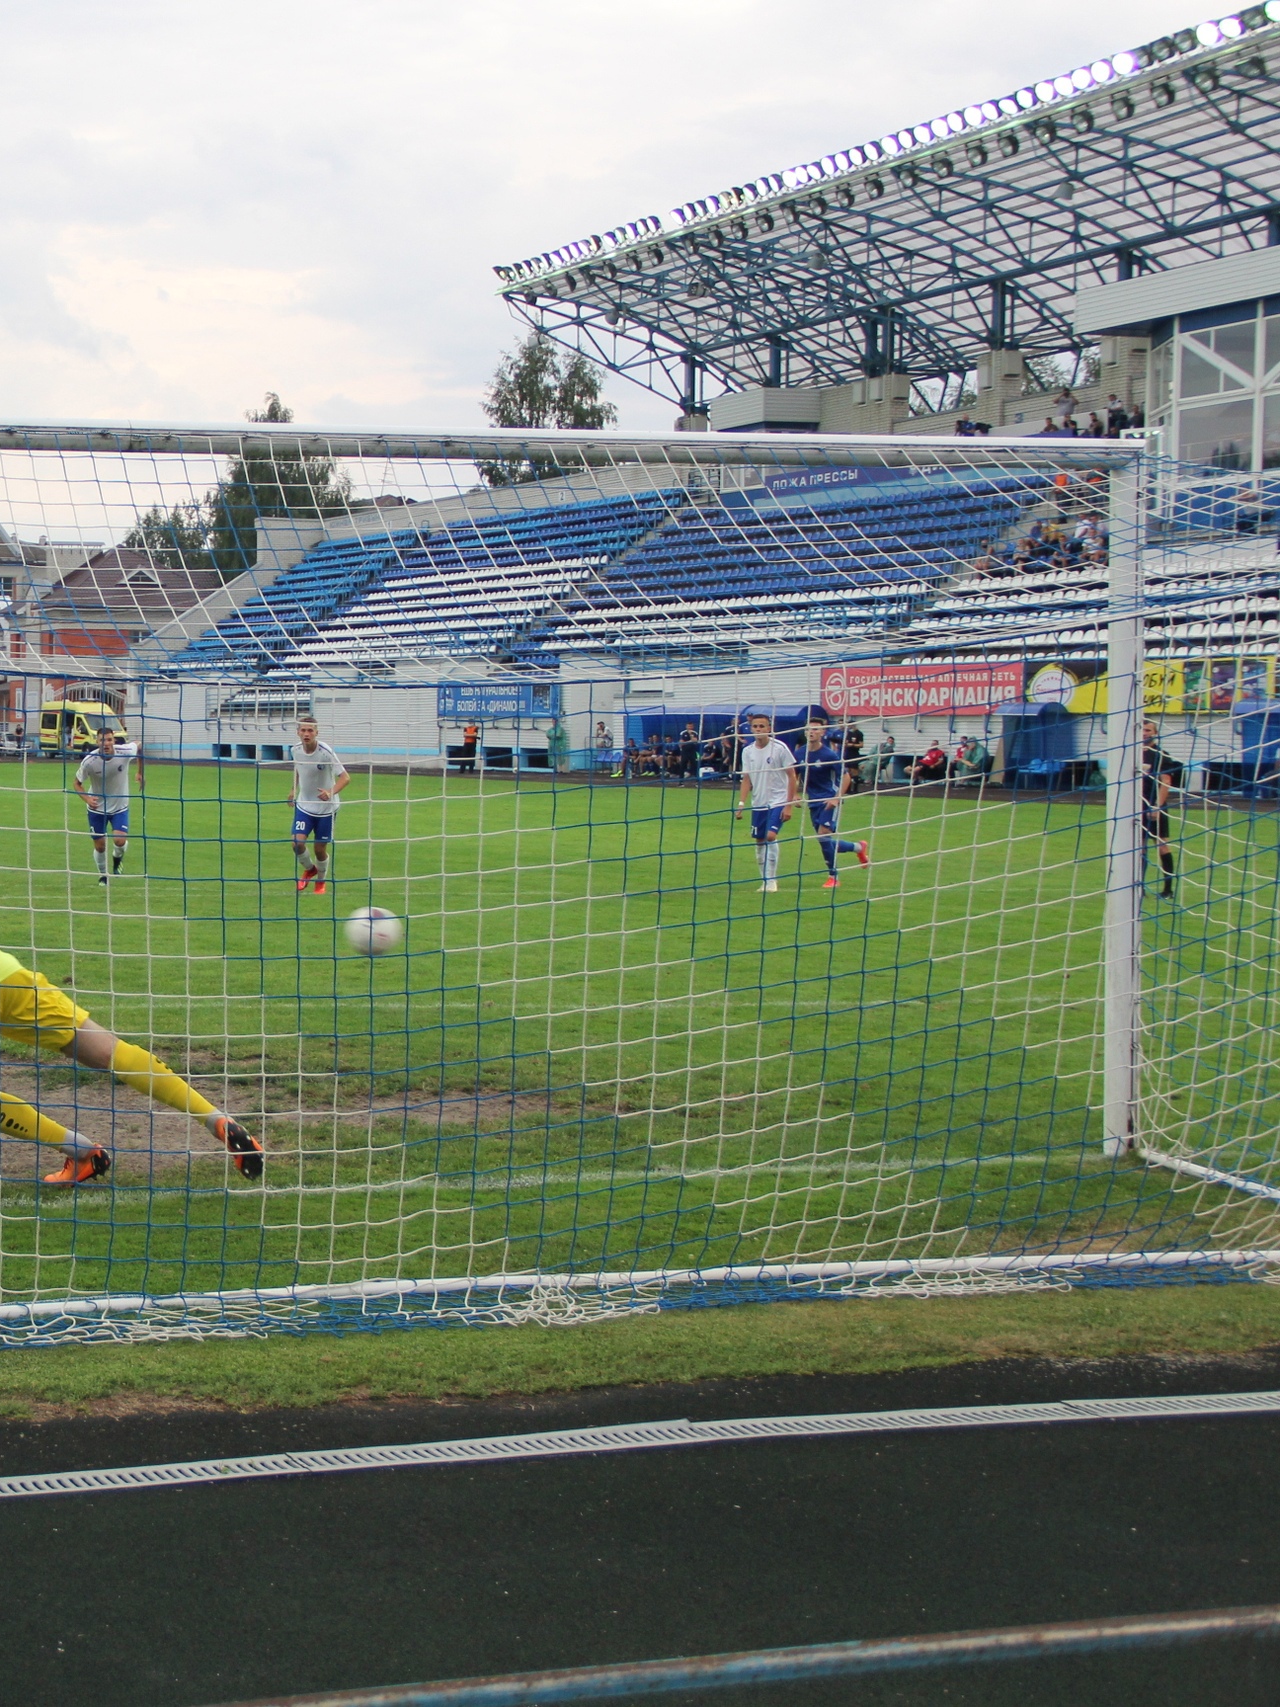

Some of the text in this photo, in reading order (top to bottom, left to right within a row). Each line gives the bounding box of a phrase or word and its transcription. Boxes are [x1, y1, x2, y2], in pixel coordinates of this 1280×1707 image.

[809, 469, 858, 485] ПРЕССЫ
[938, 672, 989, 681] АПТЕЧНАЯ
[992, 671, 1016, 681] СЕТЬ
[849, 685, 1017, 709] БРЯНСКФАРМАЦИЯ
[457, 698, 476, 712] БОЛЕЙ
[295, 821, 306, 831] 20
